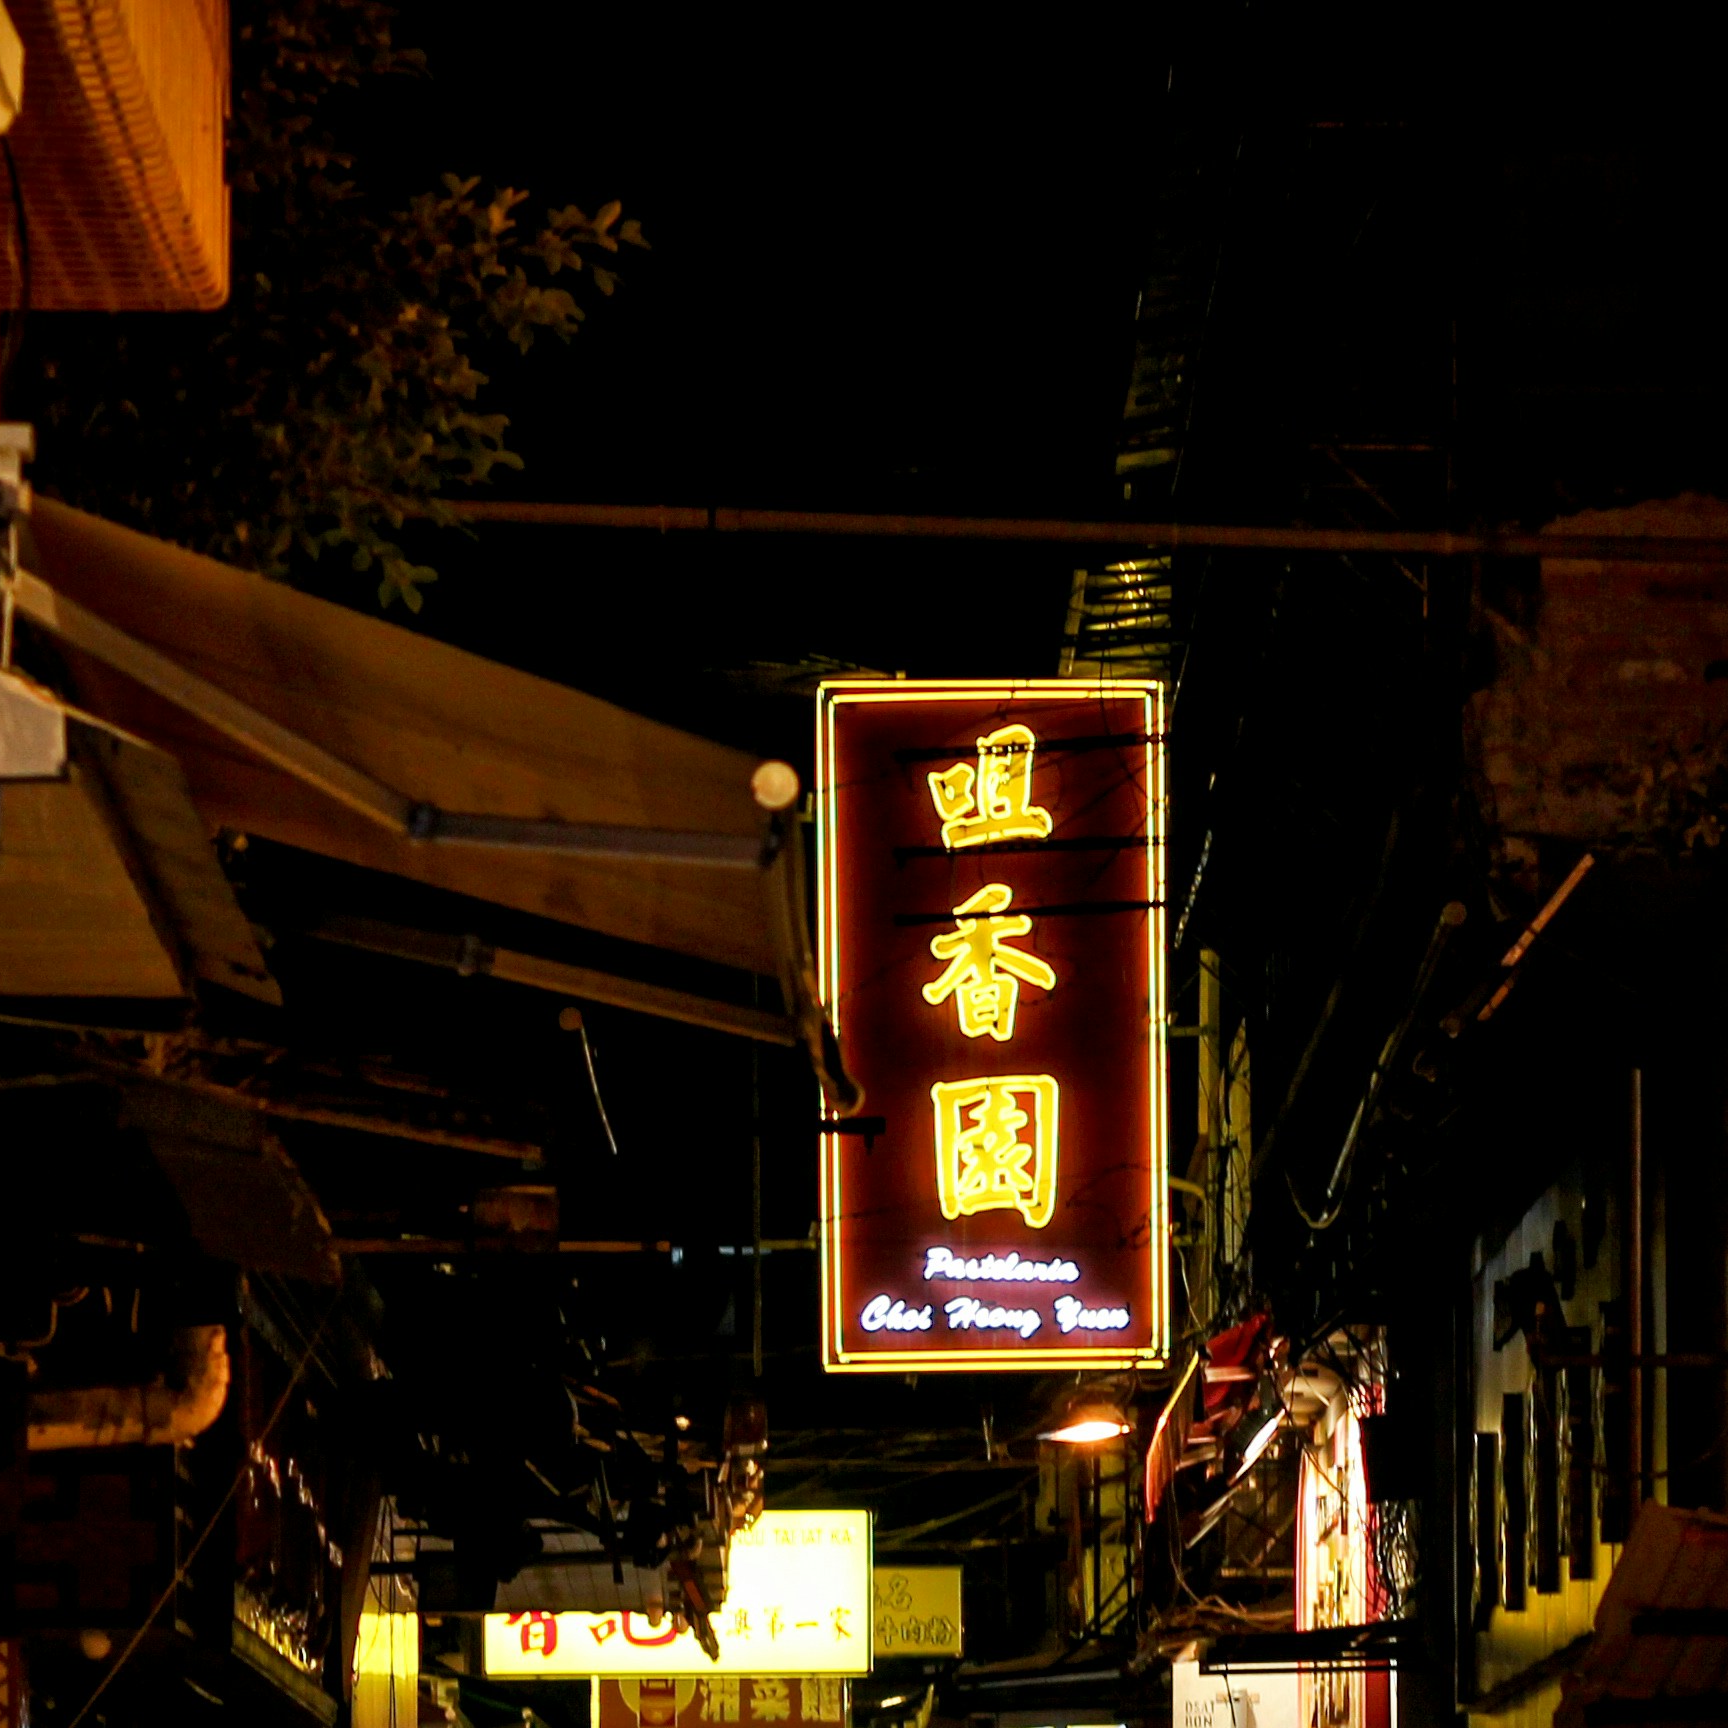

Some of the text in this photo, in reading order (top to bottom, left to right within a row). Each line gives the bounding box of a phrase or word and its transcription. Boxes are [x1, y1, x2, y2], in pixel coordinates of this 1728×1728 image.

[922, 723, 1061, 1228] 咀香園
[923, 1246, 1080, 1282] Pastelaria
[860, 1294, 1130, 1339] Choi Heong Yuen
